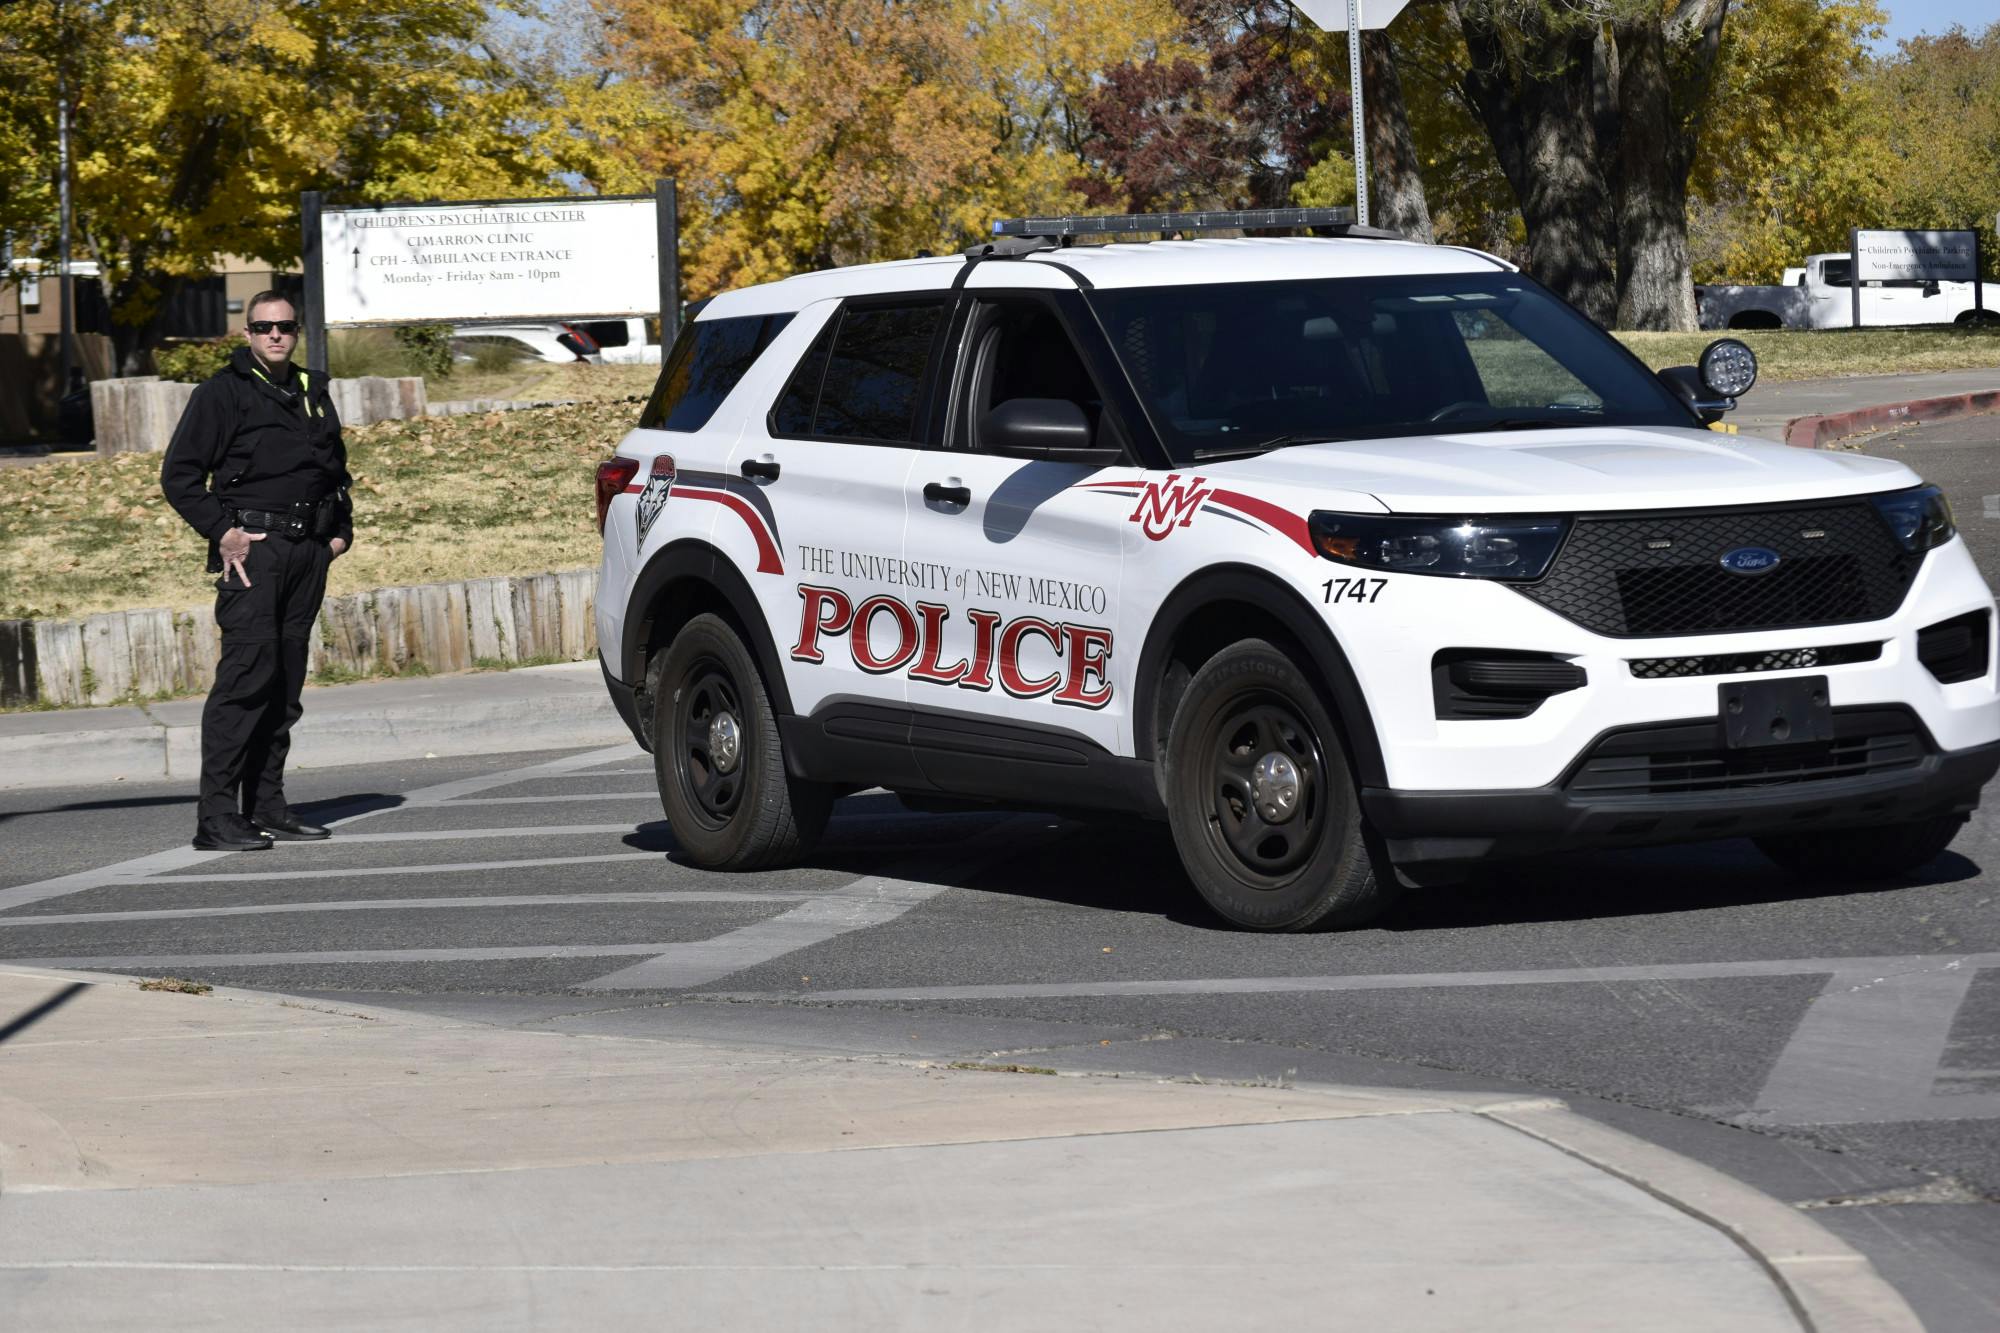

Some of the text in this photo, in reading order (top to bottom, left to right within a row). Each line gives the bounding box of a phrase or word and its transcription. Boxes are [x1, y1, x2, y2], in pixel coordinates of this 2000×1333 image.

[353, 210, 586, 228] CHILDREN'S PSYCHIATRIC CENTER
[407, 232, 534, 247] CIMARRON CLINIC
[370, 255, 398, 266] CPH
[411, 251, 497, 265] AMBULANCE
[500, 249, 574, 262] ENTRANCE
[1943, 245, 1970, 256] Parking
[383, 272, 434, 286] Monday
[446, 270, 485, 285] Friday
[489, 270, 515, 280] 8am
[527, 268, 561, 283] 10pm
[1737, 552, 1767, 567] Ford
[799, 545, 1107, 615] THE UNIVERSITY of NEW MEXICO
[1321, 578, 1389, 604] 1747
[790, 583, 1114, 711] POLICE
